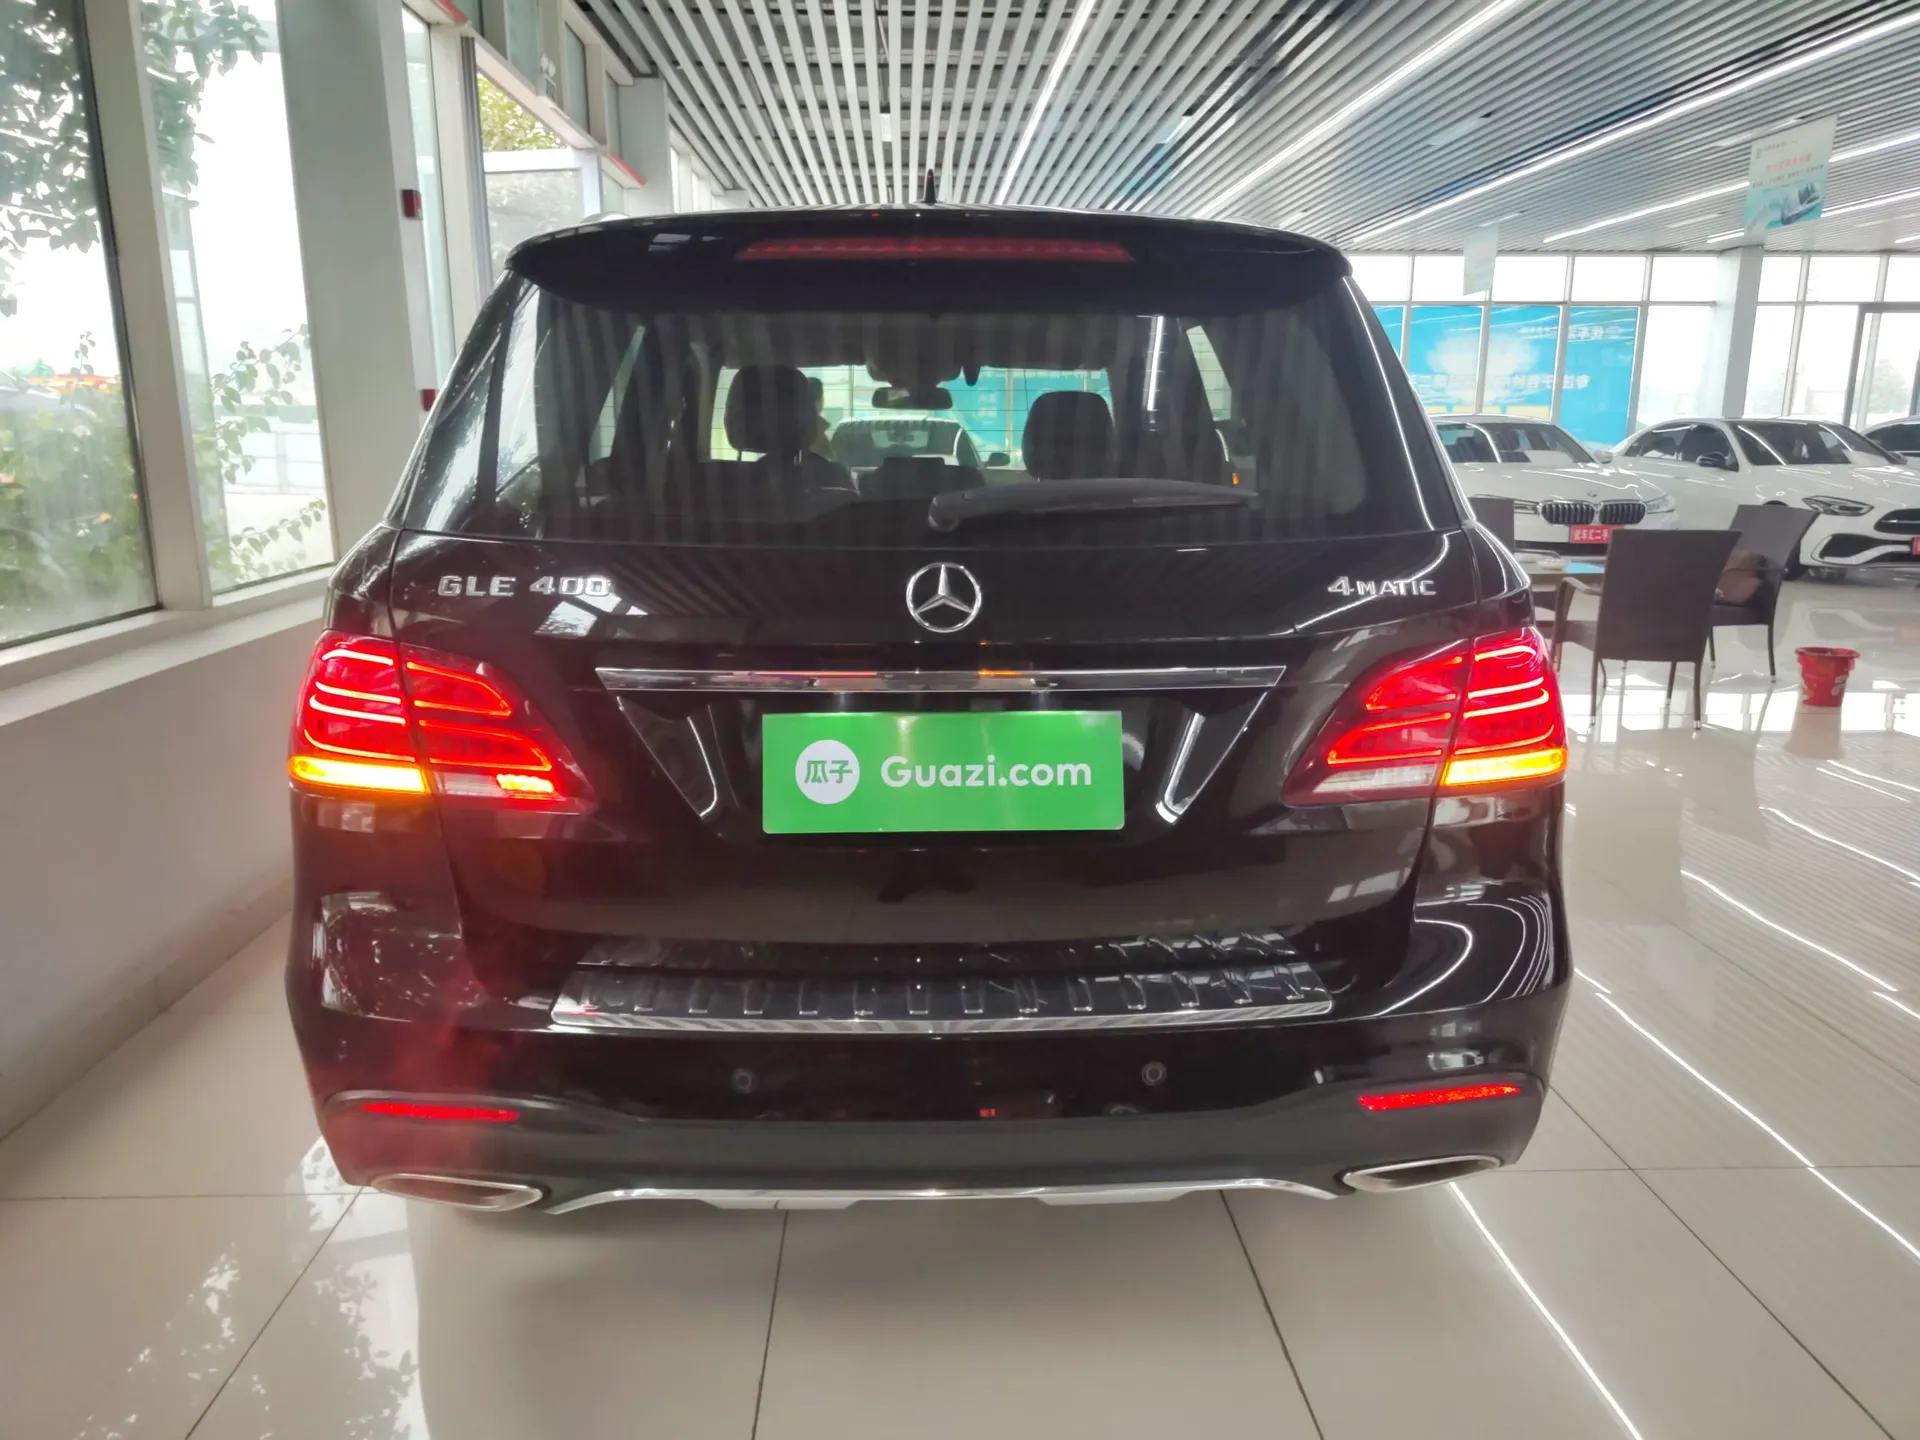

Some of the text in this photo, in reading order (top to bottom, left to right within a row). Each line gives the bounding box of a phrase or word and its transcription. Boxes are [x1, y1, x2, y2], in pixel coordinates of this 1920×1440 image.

[437, 575, 610, 597] GLE 400
[1327, 576, 1437, 596] 4MATIC
[804, 760, 853, 784] 瓜子
[881, 754, 1092, 788] Guazi.com
